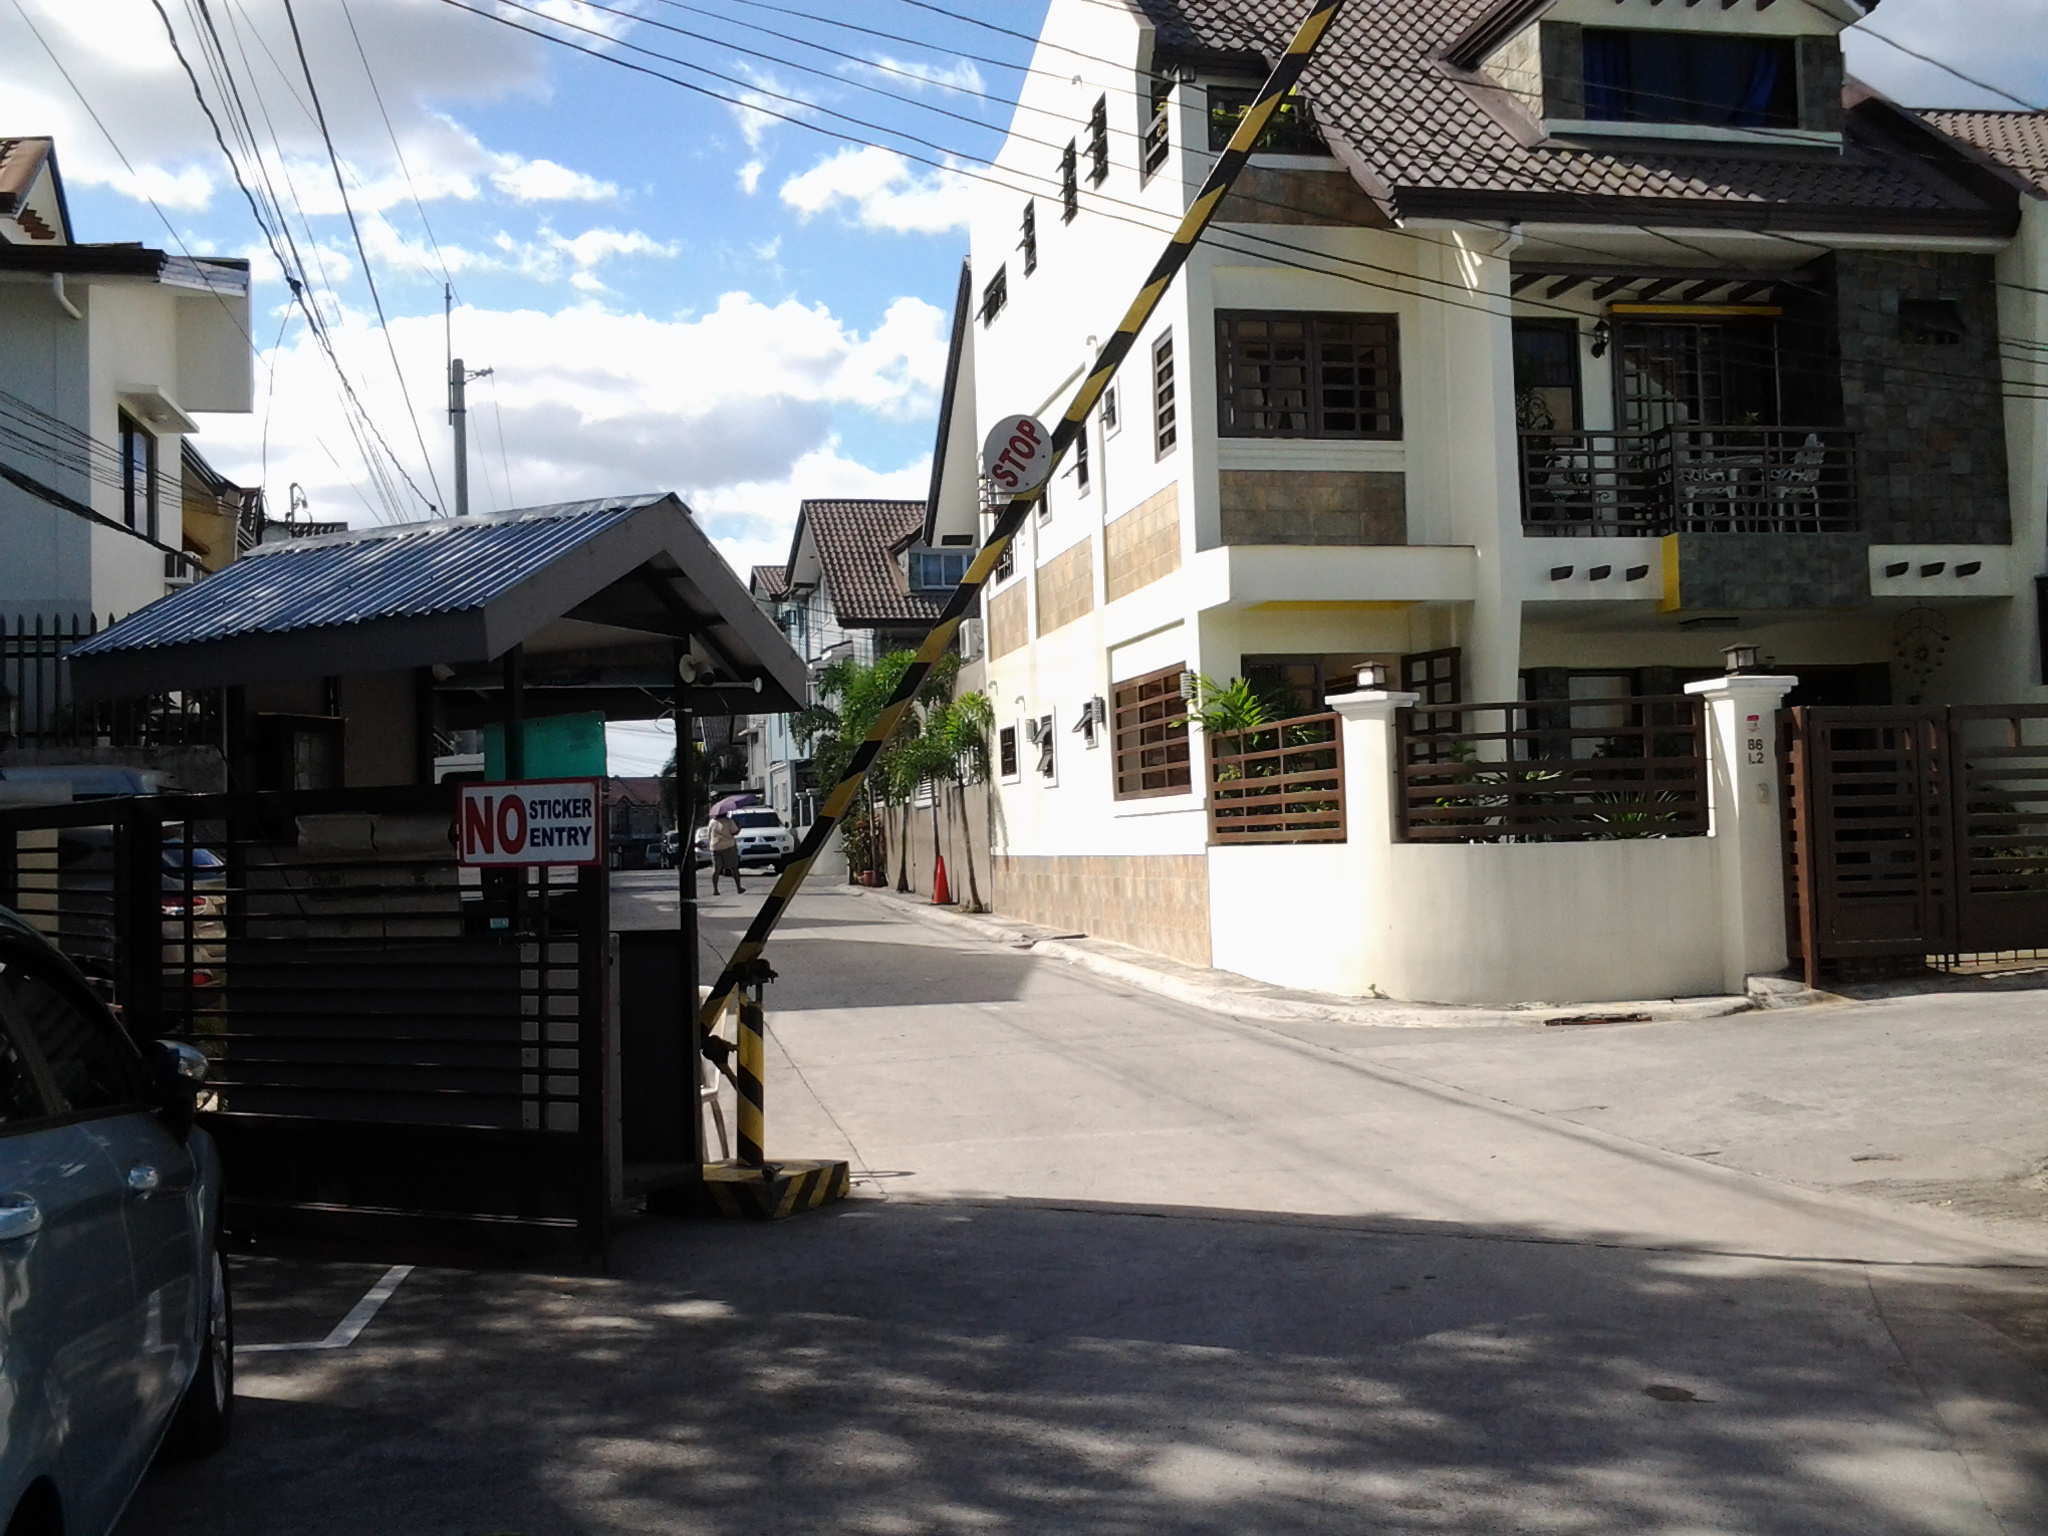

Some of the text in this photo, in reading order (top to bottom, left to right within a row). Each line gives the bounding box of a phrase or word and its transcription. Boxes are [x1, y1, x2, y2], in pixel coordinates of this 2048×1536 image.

[992, 419, 1042, 487] STOP
[1748, 738, 1763, 750] B6
[1748, 752, 1764, 765] L2
[465, 794, 592, 854] NO STICKER
[530, 826, 592, 847] ENTRY
